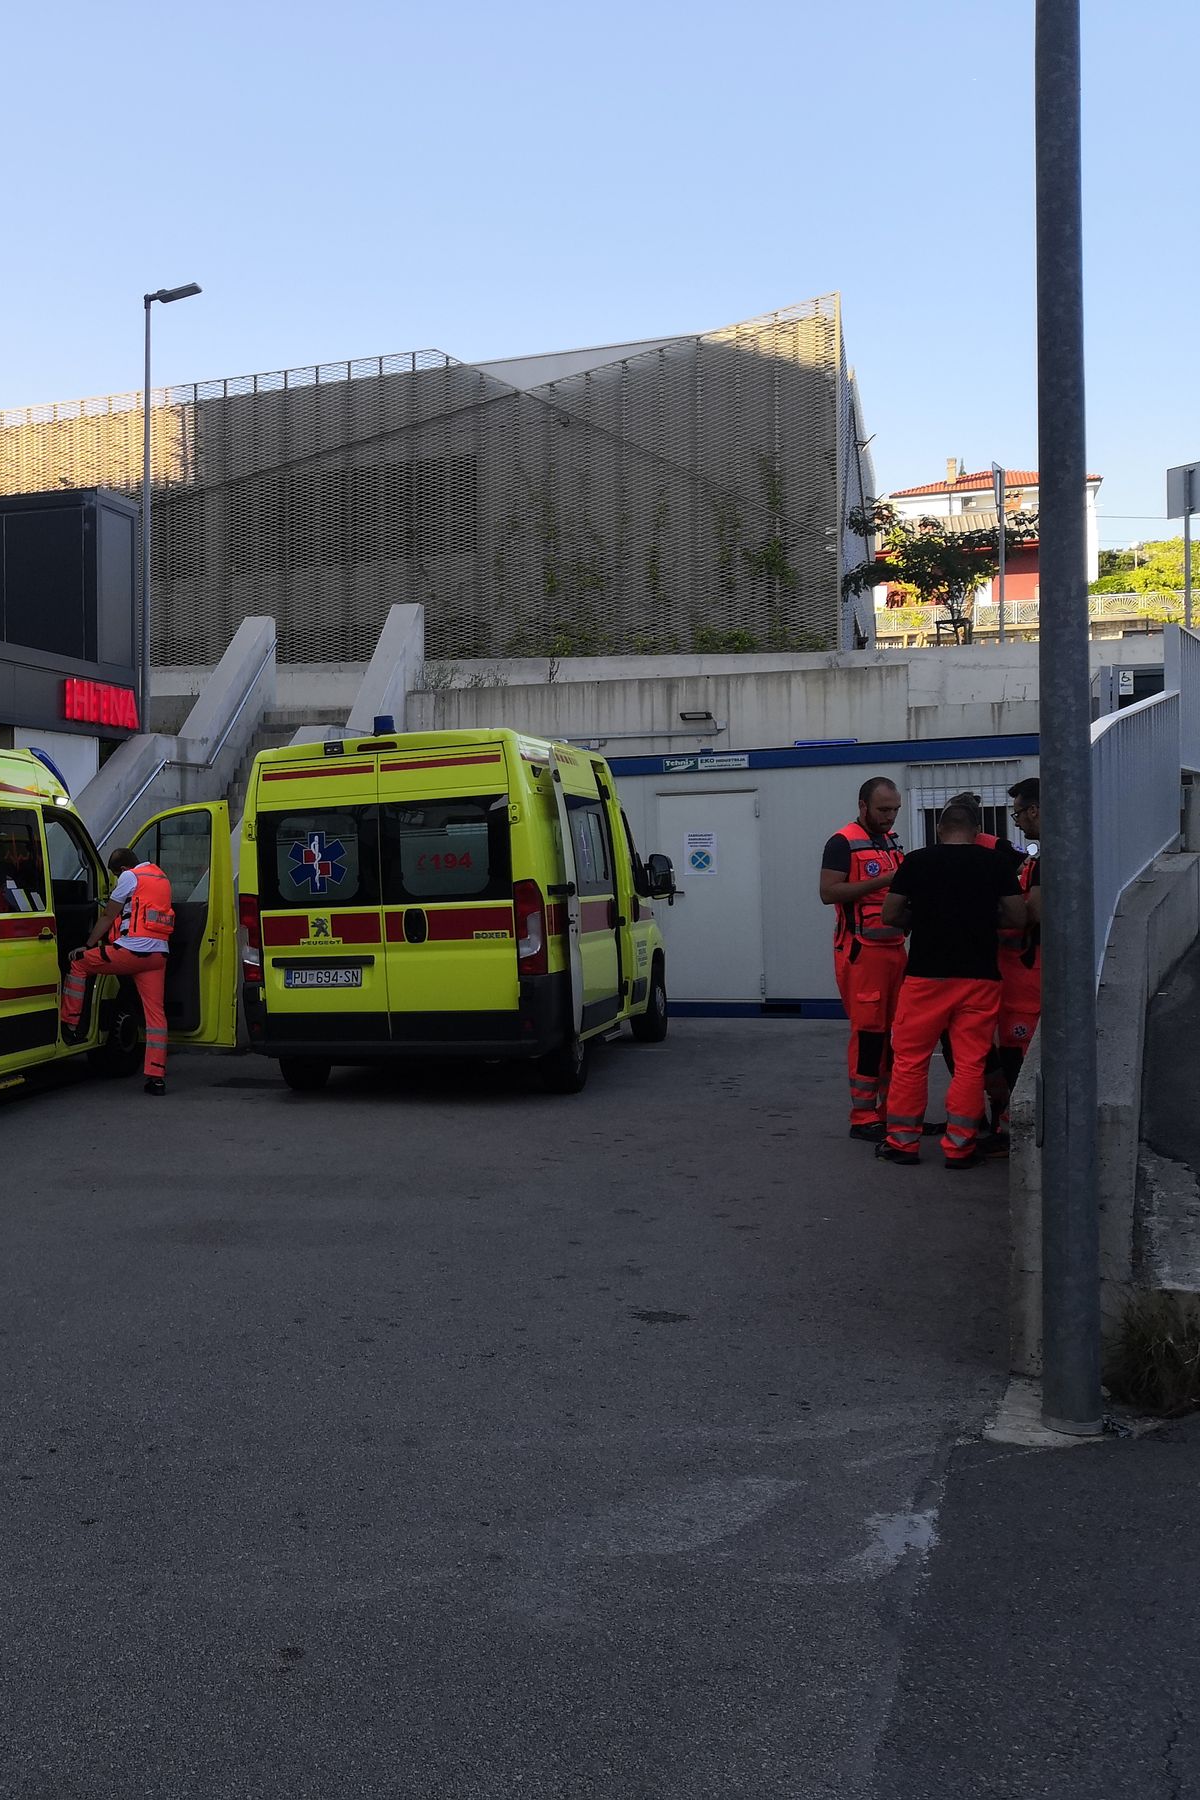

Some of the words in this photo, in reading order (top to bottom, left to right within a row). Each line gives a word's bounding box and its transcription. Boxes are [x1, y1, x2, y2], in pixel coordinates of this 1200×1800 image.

[65, 678, 139, 730] HITNA
[430, 852, 473, 871] 194
[474, 931, 508, 940] BOXER
[292, 971, 308, 984] PU
[316, 970, 359, 984] 694-SN
